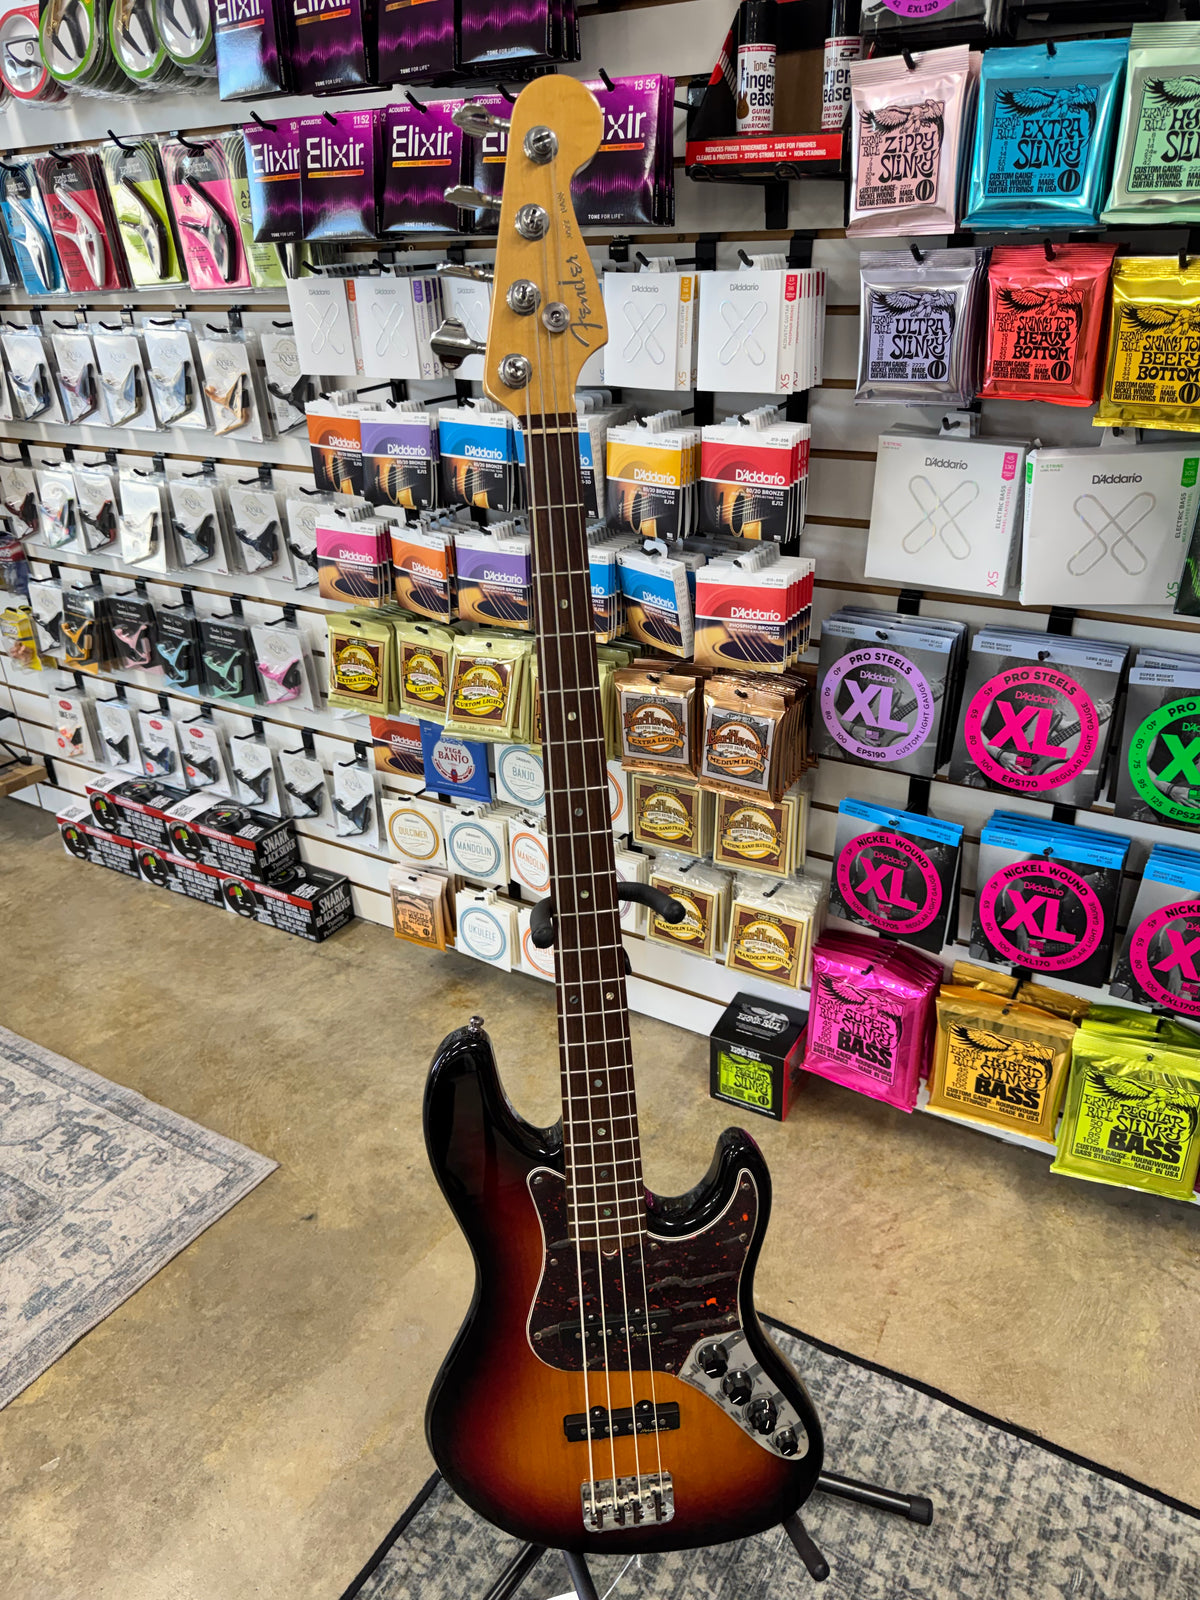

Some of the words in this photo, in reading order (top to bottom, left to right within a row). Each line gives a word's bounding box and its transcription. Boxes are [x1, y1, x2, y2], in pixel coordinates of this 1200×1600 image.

[907, 1, 939, 14] EXL120
[753, 60, 767, 72] Tone
[750, 92, 774, 106] ease
[301, 118, 322, 126] ACOUSTIC
[995, 117, 1020, 128] ERNIE
[1022, 118, 1083, 140] EXTRA
[392, 125, 453, 158] Elixir
[884, 130, 936, 154] ZIPPY
[251, 143, 300, 174] Elixir
[306, 137, 364, 168] Elixir
[1013, 138, 1084, 169] SLINKY
[878, 151, 936, 184] SLINKY
[988, 179, 1009, 187] NICKEL
[1008, 185, 1033, 193] STRINGS
[1044, 185, 1056, 193] USA
[730, 283, 759, 292] D'Addario
[558, 254, 602, 347] Fender
[895, 318, 946, 336] ULTRA
[1018, 316, 1052, 332] SKINNY
[1054, 316, 1074, 331] TOP
[890, 334, 947, 360] SLINKY
[1016, 331, 1071, 347] HEAVY
[1143, 335, 1182, 352] SKINNY
[1012, 346, 1071, 360] BOTTOM
[1140, 352, 1200, 368] BEEFY
[780, 374, 789, 389] XS
[1136, 366, 1200, 382] BOTTOM
[328, 436, 360, 449] D'Addario
[387, 444, 426, 456] D'Addario
[464, 445, 503, 459] D'Addario
[925, 457, 968, 470] D'Addario
[634, 468, 676, 485] D'Addario
[735, 469, 786, 485] D'Addario
[1092, 473, 1142, 485] D'Addario
[762, 489, 784, 497] BRONZE
[1174, 512, 1184, 538] ELECTRIC
[339, 550, 373, 563] D'Addario
[412, 562, 443, 579] D'Addario
[484, 570, 523, 584] D'Addario
[986, 570, 999, 588] XS
[1166, 582, 1178, 598] XS
[643, 591, 674, 609] D'Addario
[731, 607, 781, 621] D'Addario
[849, 652, 871, 665] PRO
[875, 652, 913, 675] STEELS
[336, 676, 357, 684] EXTRA
[358, 676, 376, 684] LIGHT
[860, 670, 896, 683] D'Addario
[1003, 671, 1030, 685] PRO
[1033, 671, 1077, 696] STEELS
[456, 700, 481, 708] CUSTOM
[482, 699, 503, 707] LIGHT
[840, 678, 908, 733] XL
[1015, 690, 1058, 705] D'Addario
[1081, 702, 1094, 730] GAUGE
[1168, 702, 1196, 717] PRO
[987, 700, 1068, 760] XL
[444, 746, 461, 754] VEGA
[856, 747, 886, 759] EPS190
[1082, 734, 1094, 758] LIGHT
[437, 751, 469, 764] BANJO
[710, 757, 740, 766] MEDIUM
[741, 760, 763, 769] LIGHT
[512, 767, 534, 782] BANJO
[1050, 758, 1084, 785] REGULAR
[1001, 774, 1038, 788] EPS170
[262, 827, 290, 855] SNARK
[399, 827, 428, 840] DULCIMER
[260, 850, 280, 868] BLACK
[280, 839, 296, 860] SILVER
[456, 840, 492, 856] MANDOLIN
[857, 836, 891, 847] NICKEL
[895, 839, 929, 869] WOUND
[518, 850, 545, 872] MANDOLIN
[873, 850, 908, 867] D'Addario
[854, 856, 918, 912] XL
[1003, 865, 1044, 879] NICKEL
[1049, 867, 1088, 897] WOUND
[1024, 882, 1064, 896] D'Addario
[319, 885, 345, 914] SNARK
[316, 910, 335, 928] BLACK
[334, 897, 351, 916] SILVER
[1001, 888, 1076, 945] XL
[468, 925, 496, 942] UKULELE
[686, 926, 703, 936] LIGHT
[737, 951, 766, 961] MANDOLIN
[766, 954, 790, 966] MEDIUM
[1017, 954, 1050, 968] EXL170
[845, 1008, 891, 1036] SUPER
[840, 1018, 896, 1048] SLINKY
[837, 1030, 892, 1069] BASS
[983, 1055, 1043, 1078] HYBRID
[977, 1065, 1041, 1090] SLINKY
[974, 1077, 1039, 1110] BASS
[1083, 1094, 1120, 1112] ERNIE
[1086, 1106, 1113, 1122] BALL
[1119, 1104, 1186, 1130] REGULAR
[1113, 1115, 1183, 1141] SLINKY
[1108, 1129, 1182, 1164] BASS
[1075, 1150, 1093, 1160] BASS
[1094, 1154, 1121, 1165] STRINGS
[1134, 1163, 1153, 1174] MADE
[1164, 1170, 1179, 1178] USA
[1076, 1143, 1104, 1155] CUSTOM
[1106, 1150, 1127, 1159] GAUGE
[1130, 1156, 1180, 1172] ROUNDWOUND
